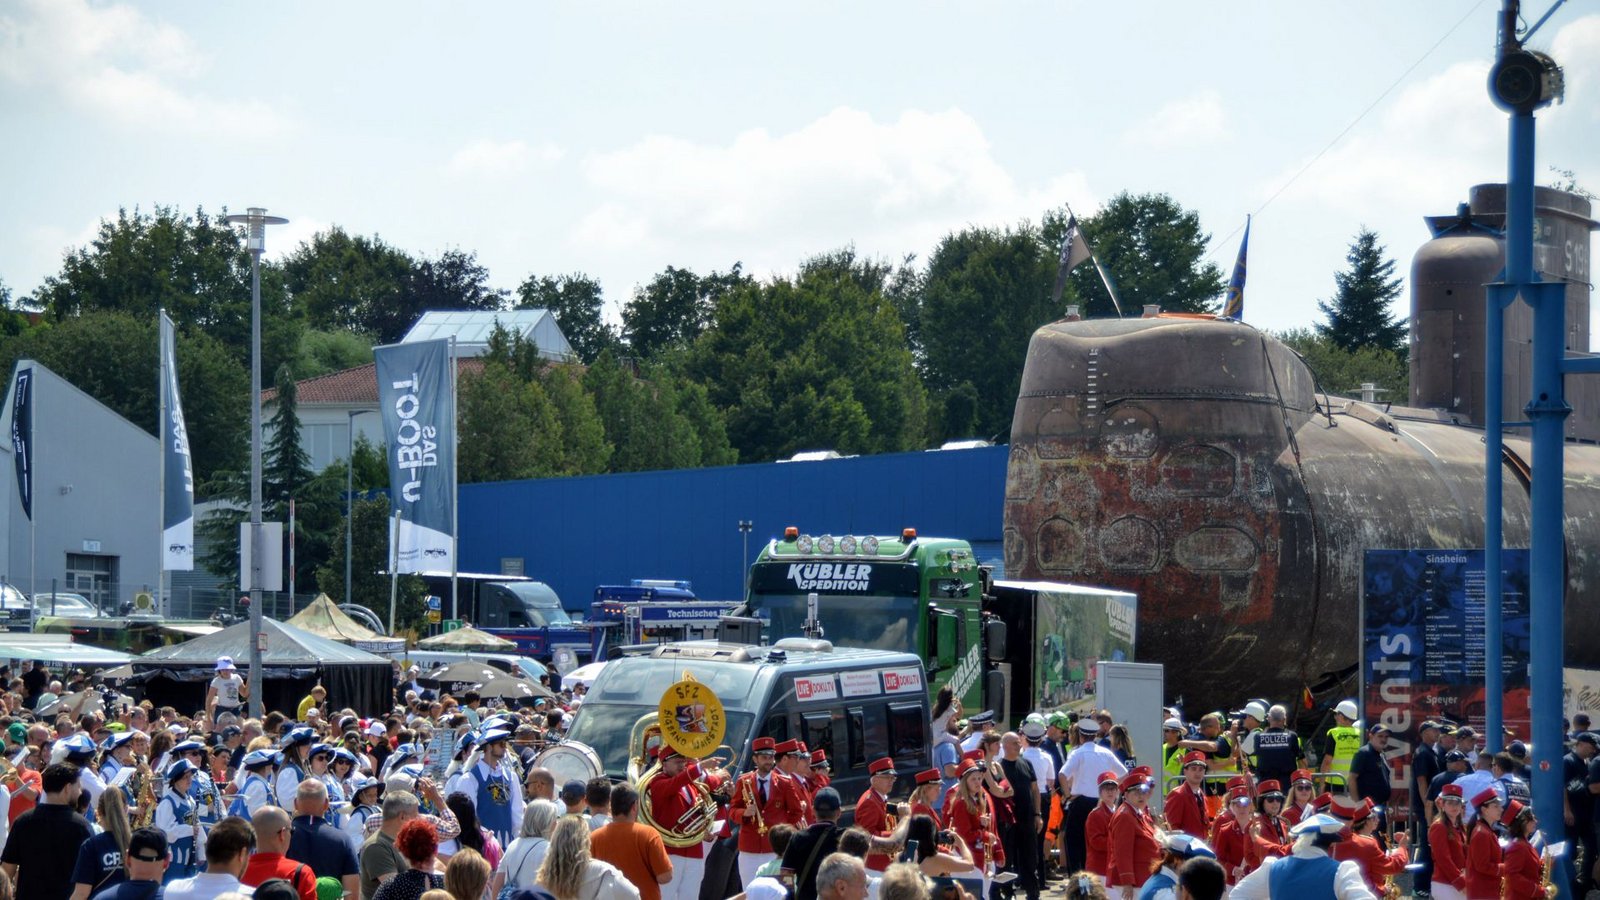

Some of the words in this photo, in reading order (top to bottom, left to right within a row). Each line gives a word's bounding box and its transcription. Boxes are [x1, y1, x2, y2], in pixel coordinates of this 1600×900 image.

[1426, 554, 1467, 564] Sinsheim
[787, 563, 872, 588] KÜBLER
[801, 580, 869, 591] SPEDITION
[667, 609, 718, 618] Technisches
[675, 684, 700, 699] SFZ
[797, 681, 811, 697] LIVE
[1426, 694, 1458, 706] Speyer
[1372, 633, 1411, 790] Events
[664, 709, 687, 746] BIGBAND
[1260, 735, 1289, 744] POLIZEI
